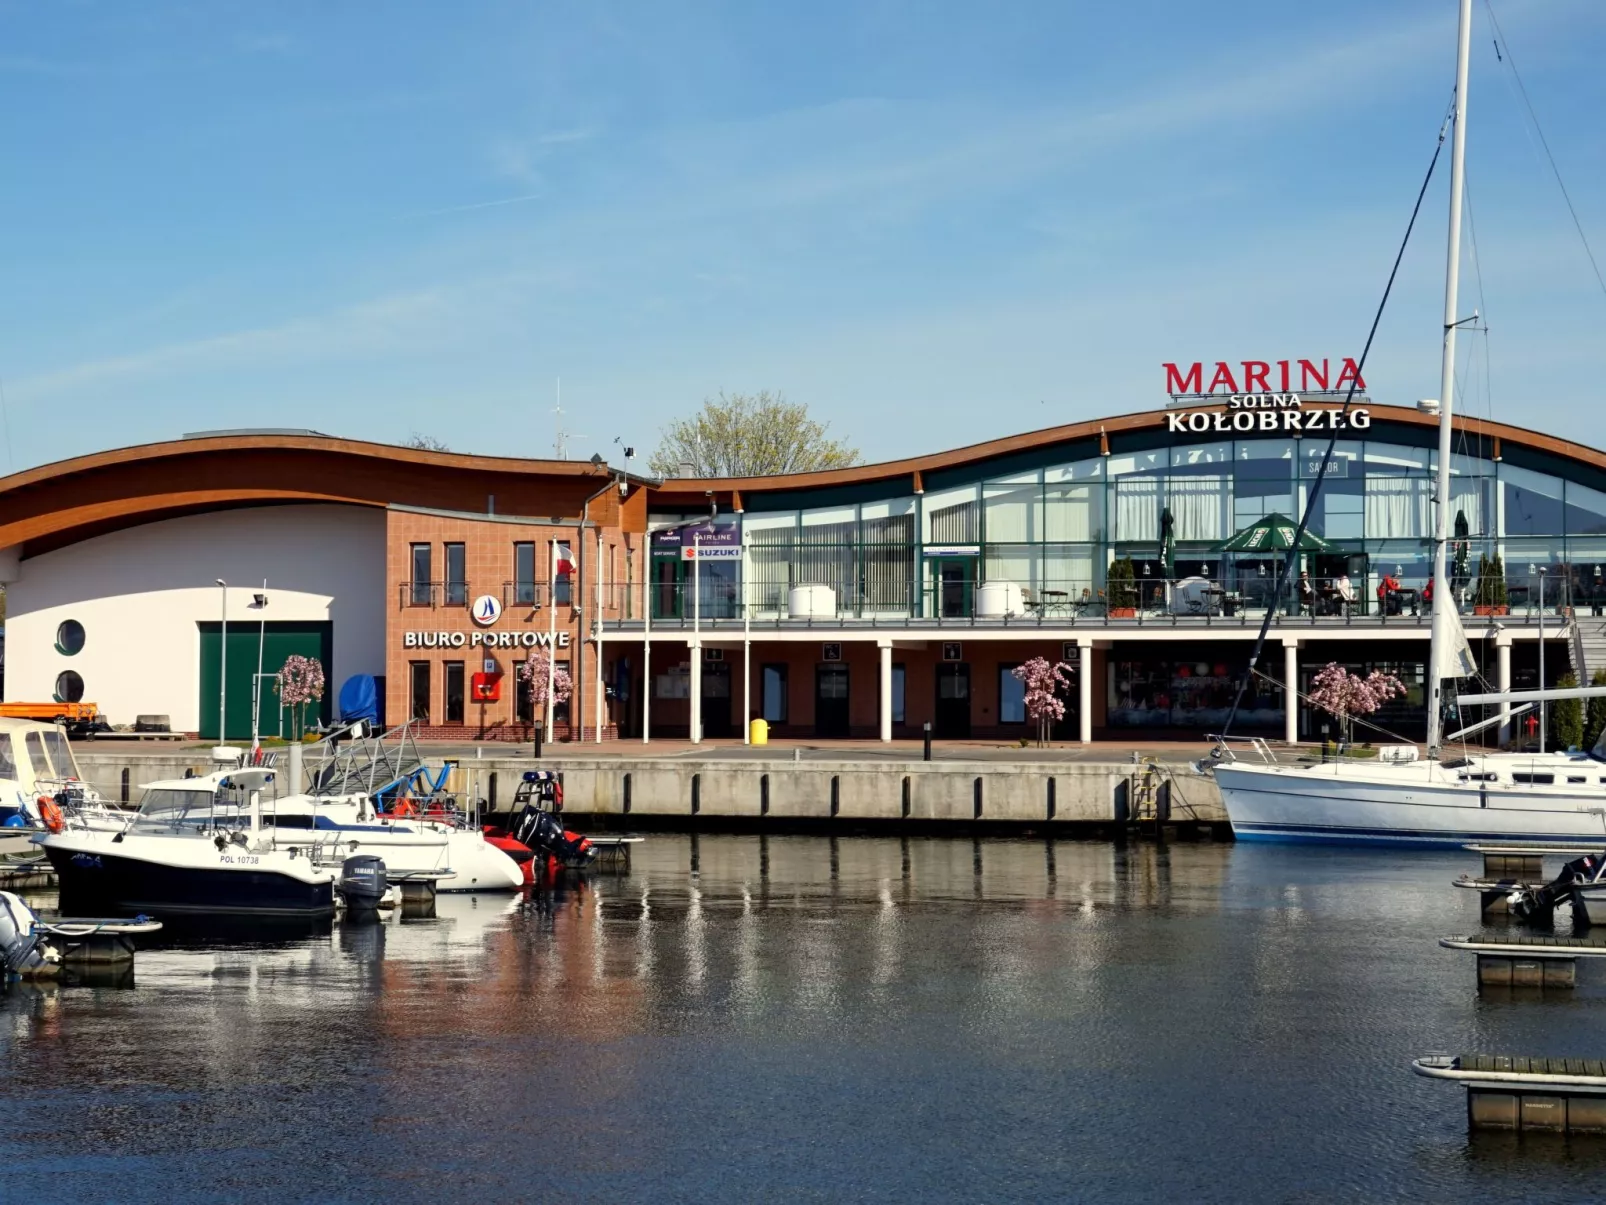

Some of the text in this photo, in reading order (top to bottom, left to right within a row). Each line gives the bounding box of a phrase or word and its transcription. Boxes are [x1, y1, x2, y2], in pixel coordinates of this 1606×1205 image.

[1162, 358, 1367, 394] MARINA
[1230, 393, 1302, 409] SOLNA
[1166, 409, 1371, 433] KOŁOBRZEG
[405, 632, 569, 647] BIURO PORTOWE
[220, 856, 259, 864] POL 10738
